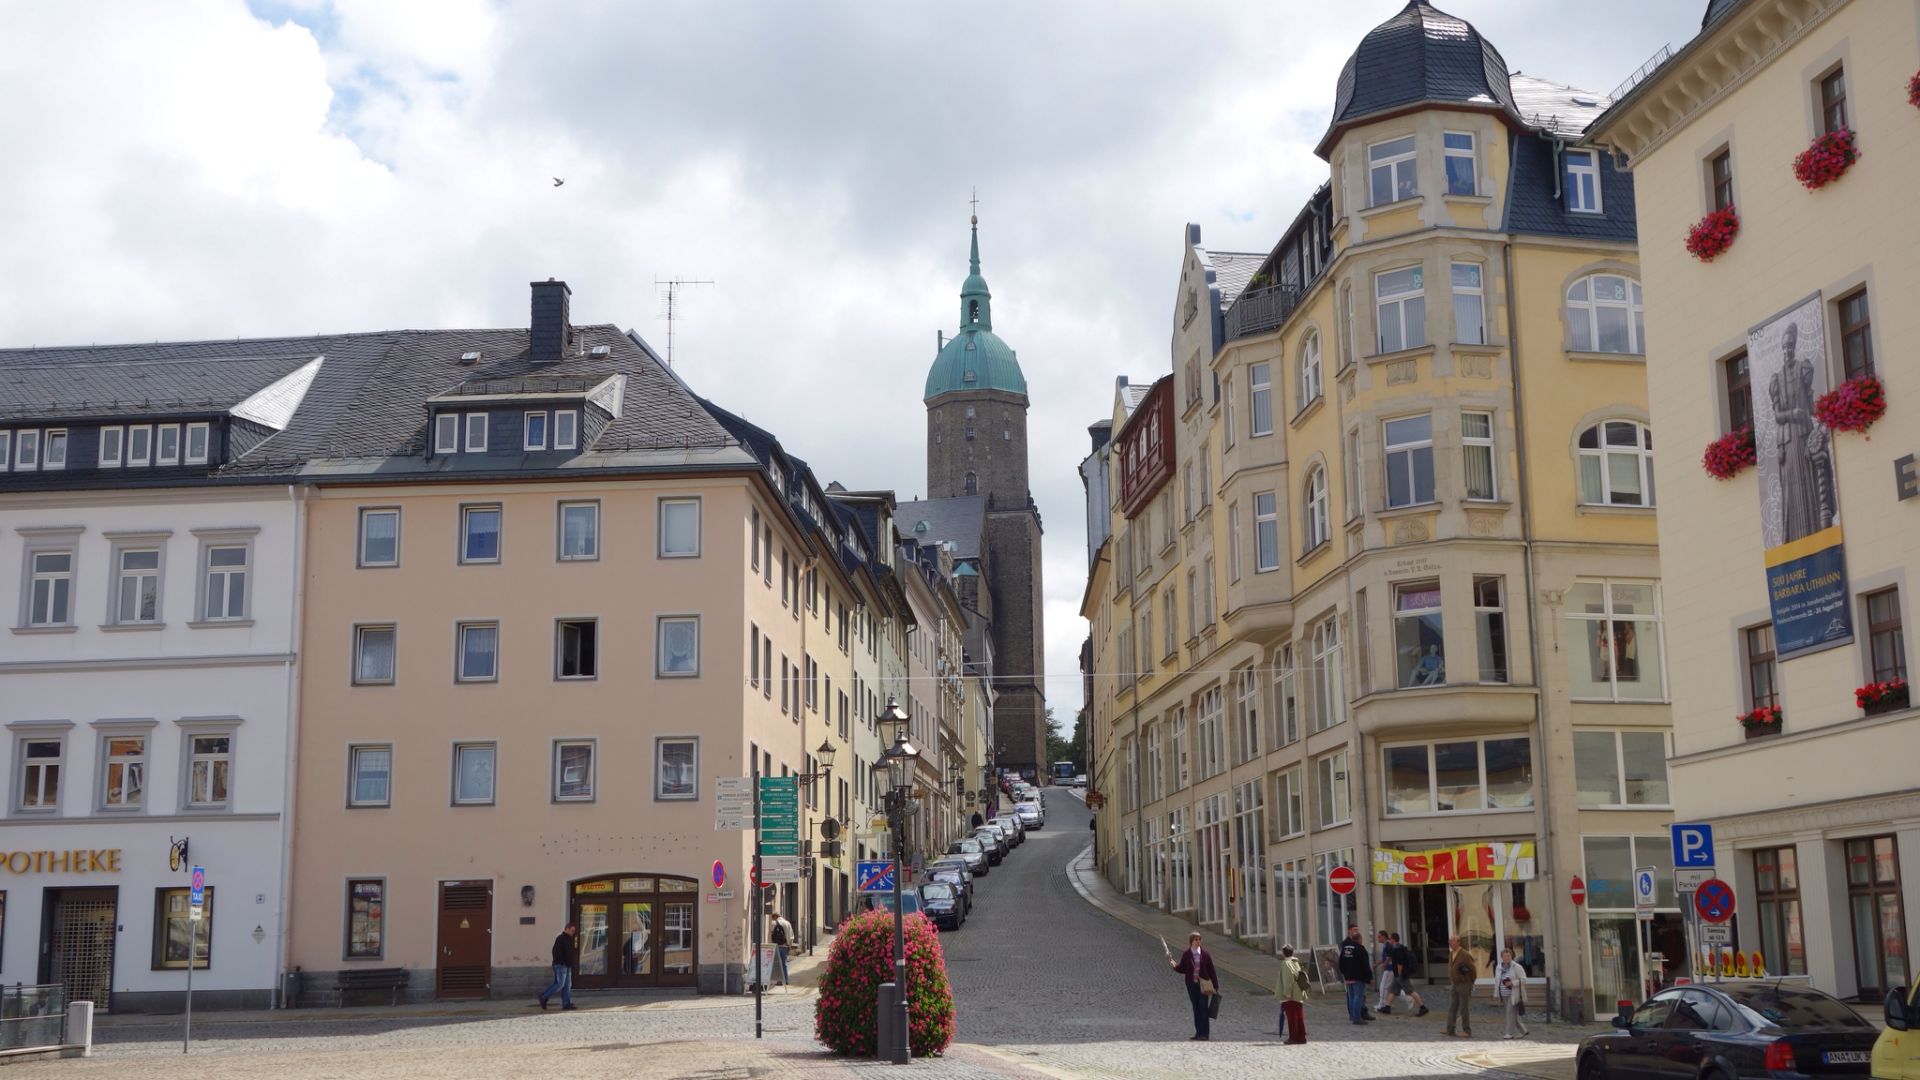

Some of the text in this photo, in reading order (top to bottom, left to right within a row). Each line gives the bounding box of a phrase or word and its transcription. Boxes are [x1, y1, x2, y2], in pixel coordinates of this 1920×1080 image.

[1773, 570, 1841, 601] BARBARA UTHMANN
[1785, 568, 1807, 586] JAHRE
[1681, 829, 1704, 862] P
[1403, 847, 1495, 883] SALE
